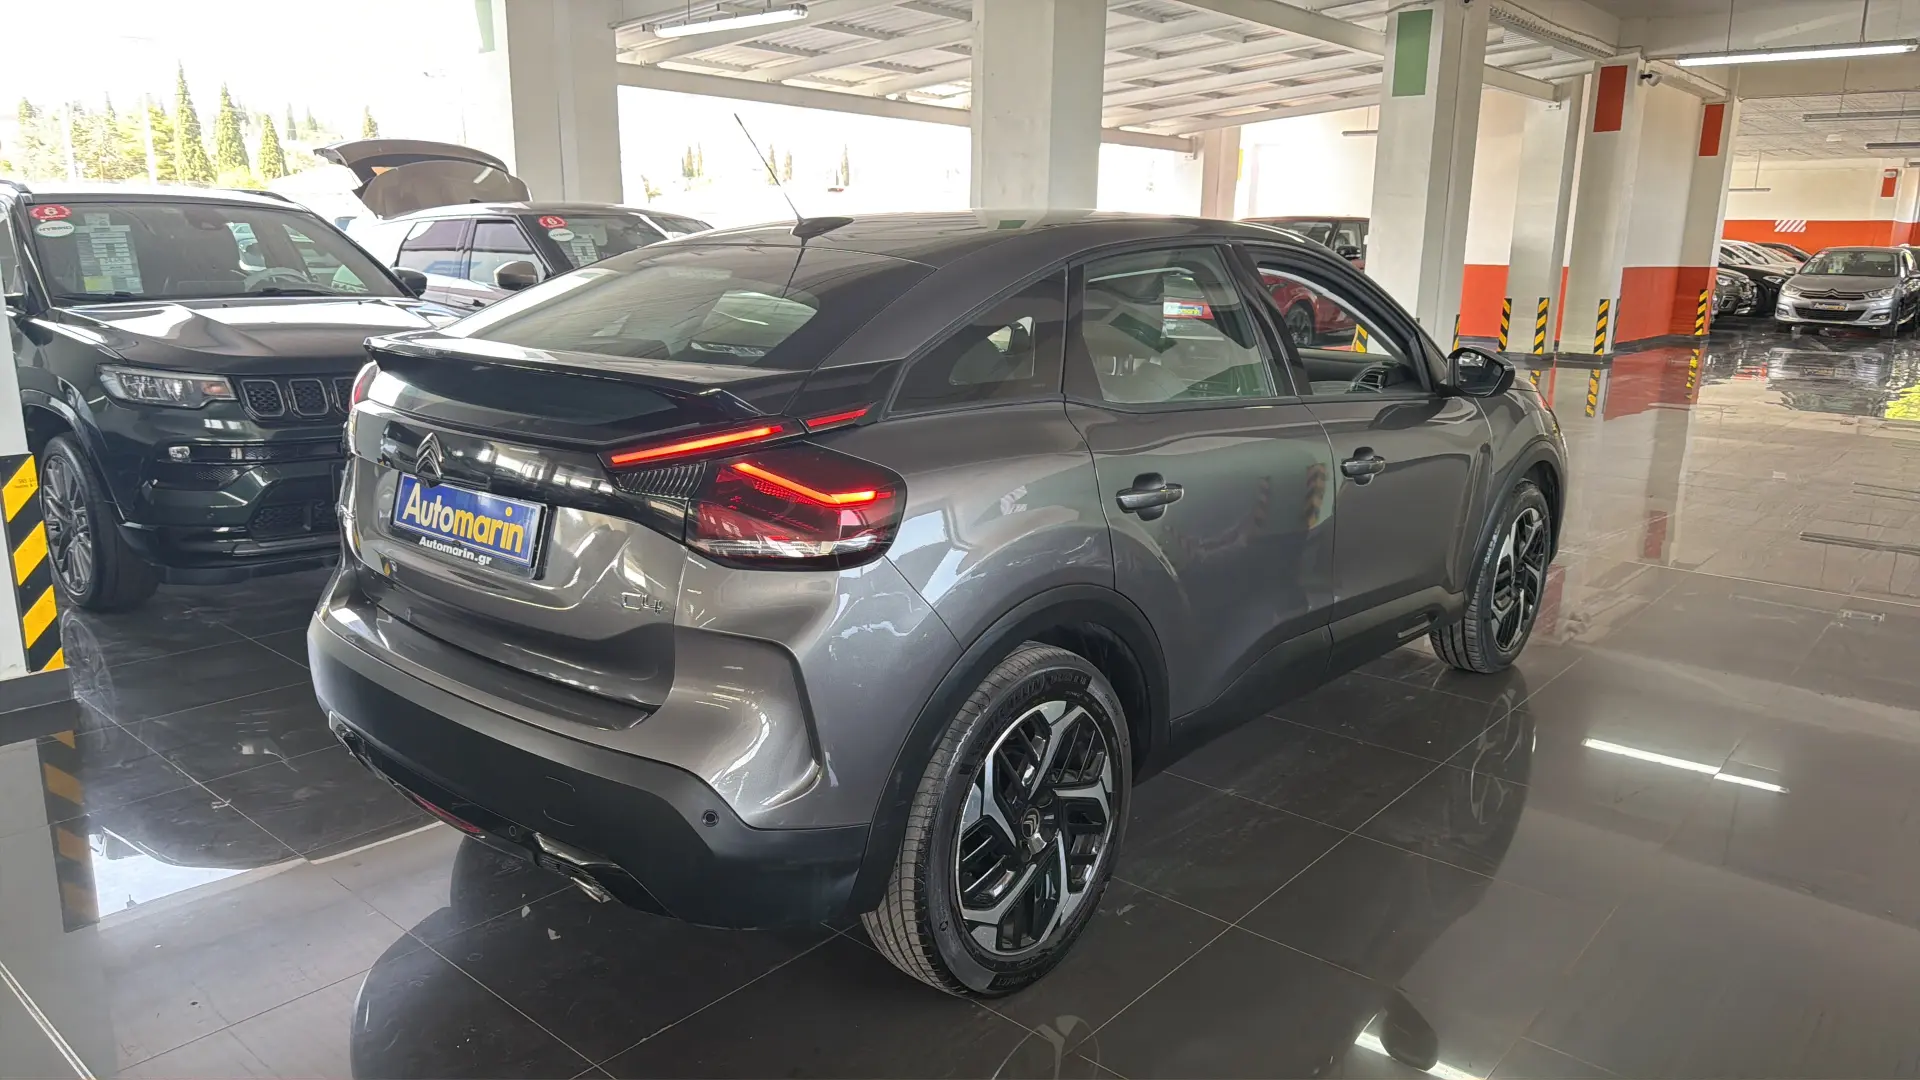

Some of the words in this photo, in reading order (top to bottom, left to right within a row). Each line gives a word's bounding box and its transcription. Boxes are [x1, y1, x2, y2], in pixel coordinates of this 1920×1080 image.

[402, 483, 524, 553] Automarin
[419, 536, 492, 566] Automarin.gr
[621, 591, 664, 615] C4
